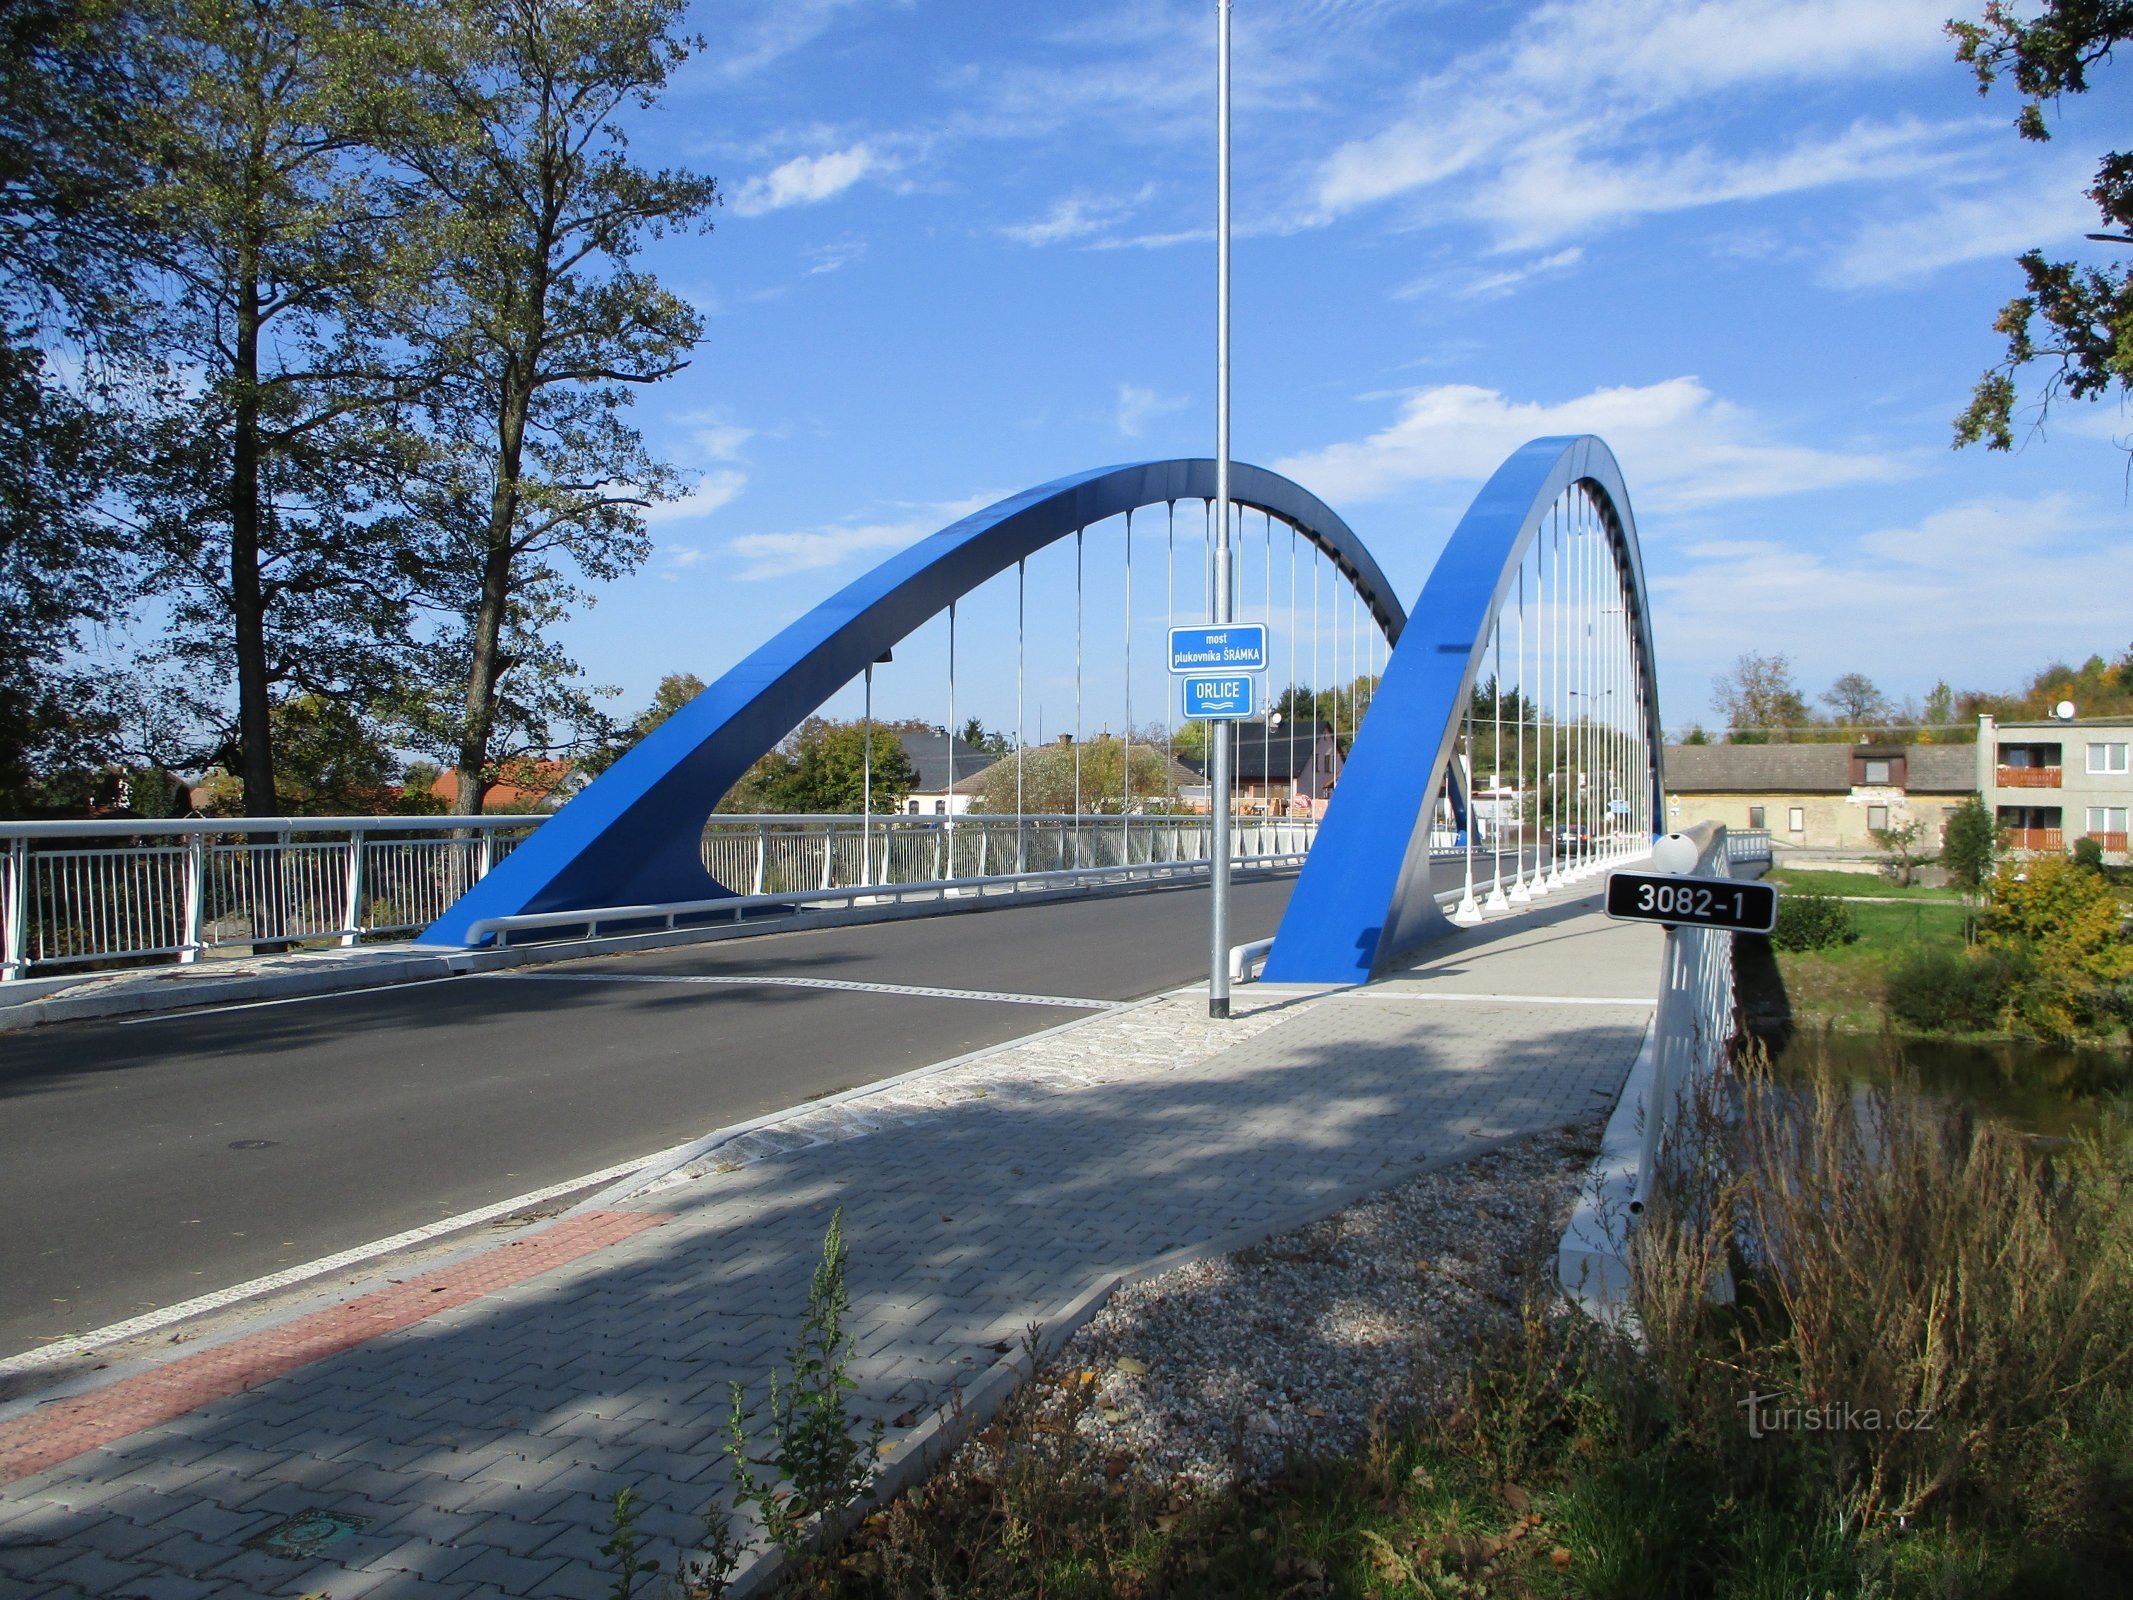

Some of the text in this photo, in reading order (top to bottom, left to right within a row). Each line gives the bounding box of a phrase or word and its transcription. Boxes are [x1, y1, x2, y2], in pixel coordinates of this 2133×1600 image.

[1206, 633, 1227, 644] most
[1175, 647, 1259, 665] plukovníka ŠRÁMKA
[1196, 682, 1240, 698] ORLICE
[1637, 884, 1743, 919] 3082-1
